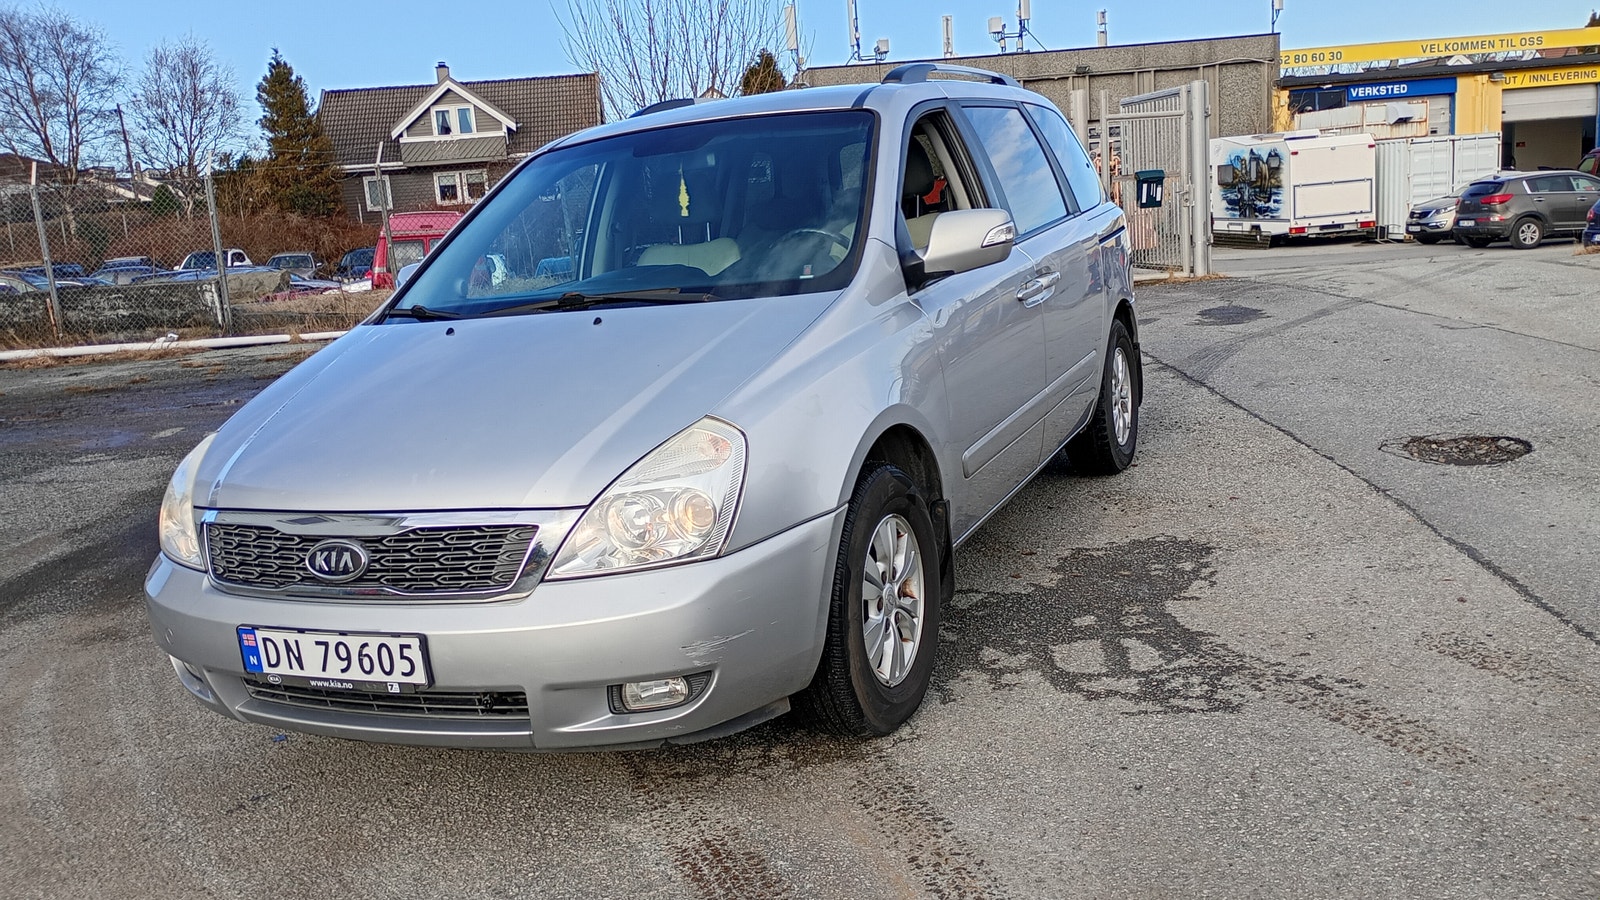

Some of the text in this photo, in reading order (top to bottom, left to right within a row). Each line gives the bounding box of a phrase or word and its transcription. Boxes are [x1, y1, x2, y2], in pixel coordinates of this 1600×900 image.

[1421, 36, 1544, 54] VELKOMMEN TIL OSS
[1293, 53, 1308, 64] 80
[1311, 52, 1325, 62] 60
[1328, 50, 1343, 61] 30
[1504, 75, 1518, 85] UT
[1528, 69, 1598, 83] INNLEVERING
[1350, 84, 1408, 97] VERKSTED
[314, 551, 354, 572] KIA
[249, 655, 258, 665] N
[261, 636, 416, 677] DN 79605
[309, 679, 354, 690] www.kia.no
